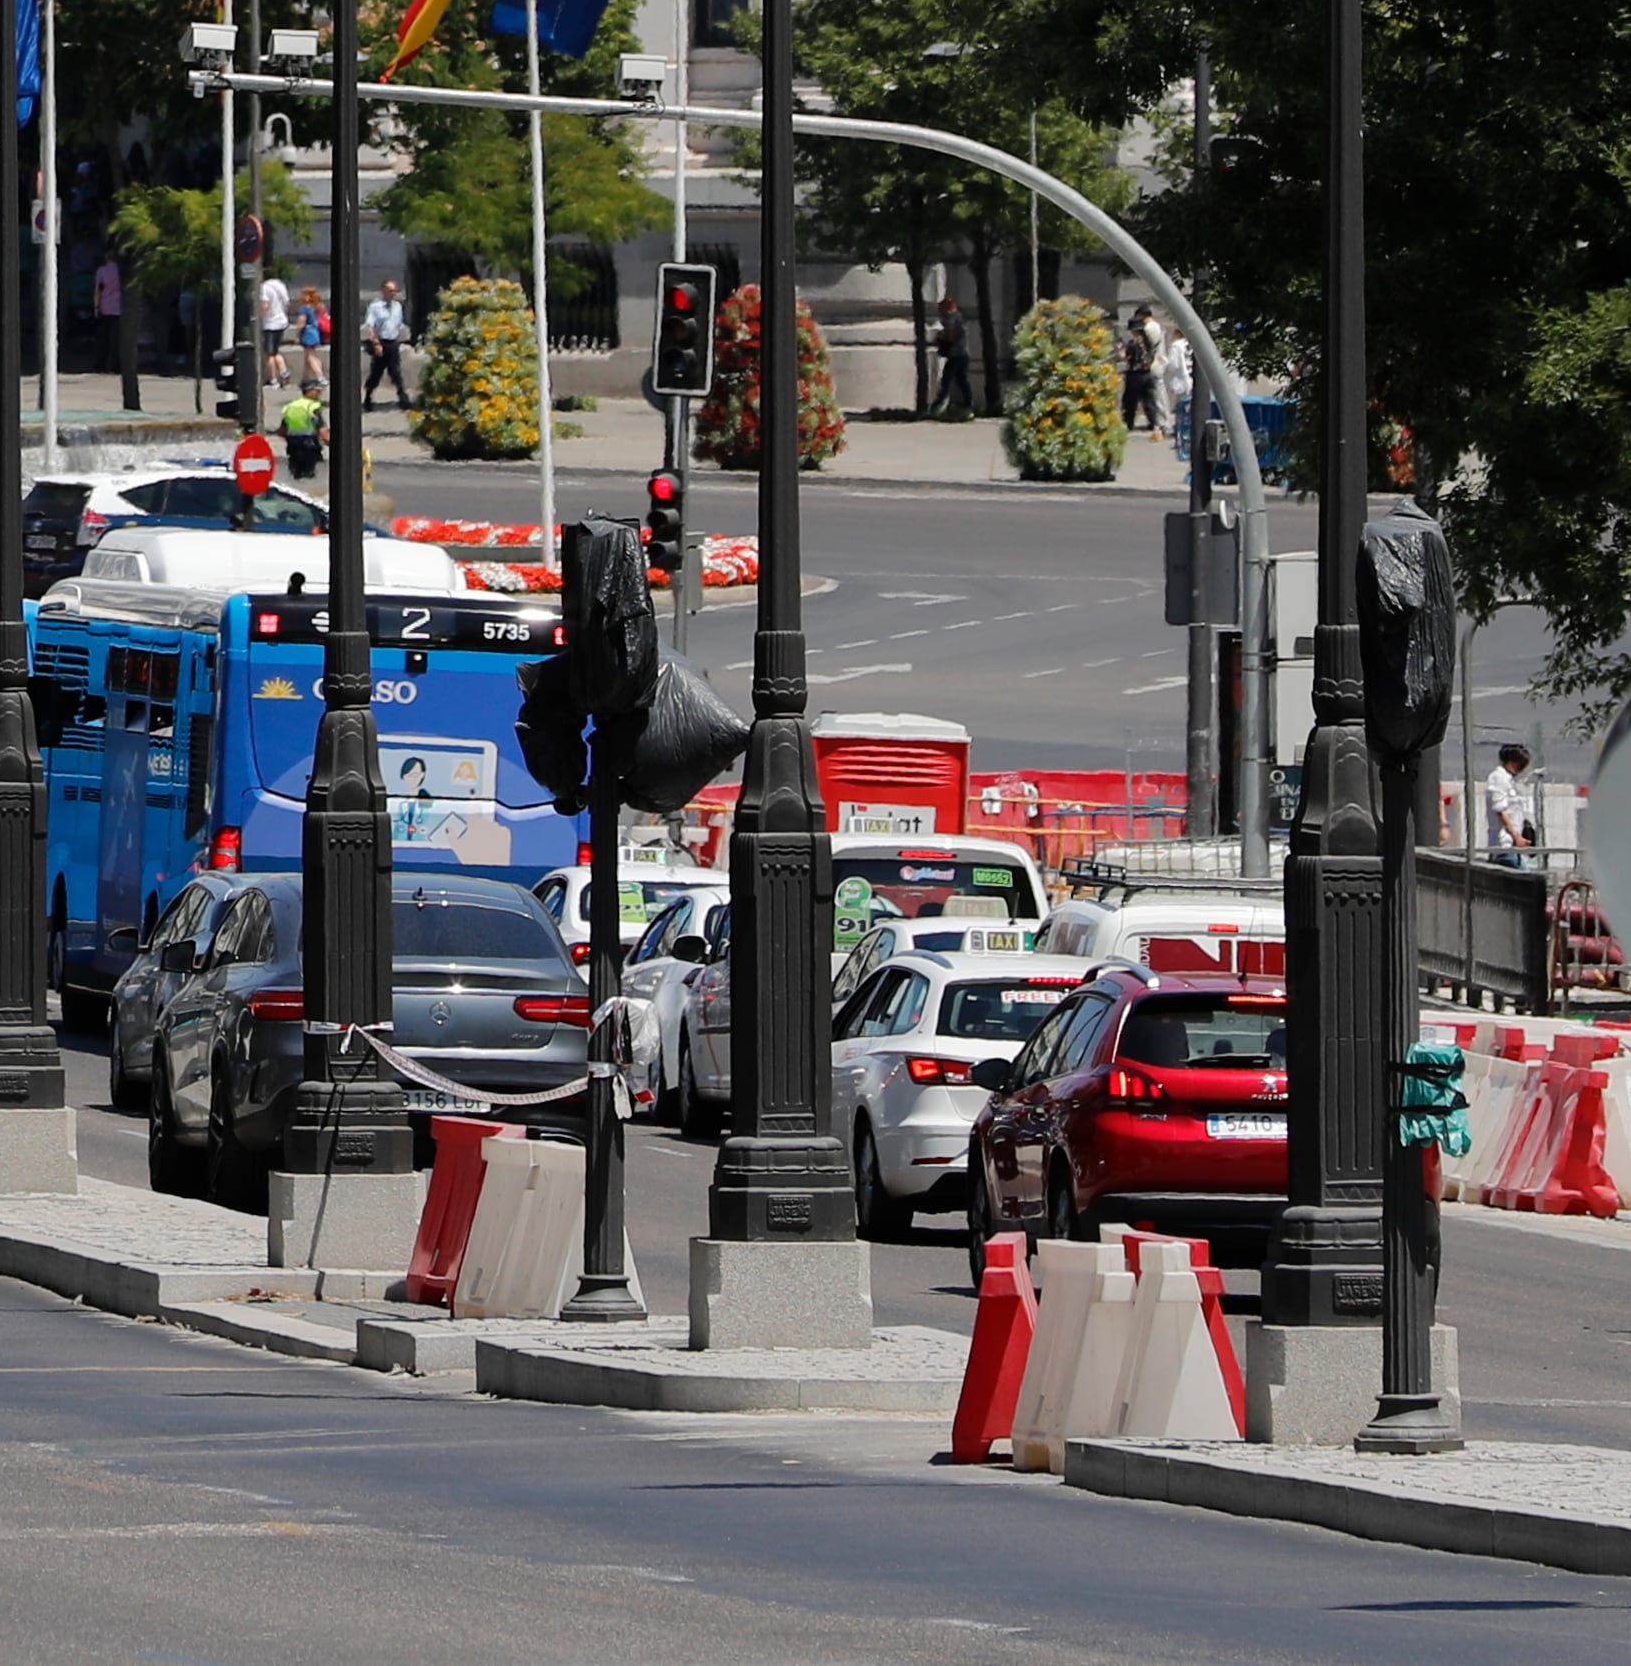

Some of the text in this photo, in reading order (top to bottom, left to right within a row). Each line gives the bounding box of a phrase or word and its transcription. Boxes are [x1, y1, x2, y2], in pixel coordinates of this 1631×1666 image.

[401, 607, 531, 641] 2 5735
[837, 917, 867, 933] 91
[988, 934, 1018, 950] TAXI
[1225, 1115, 1273, 1132] 5410
